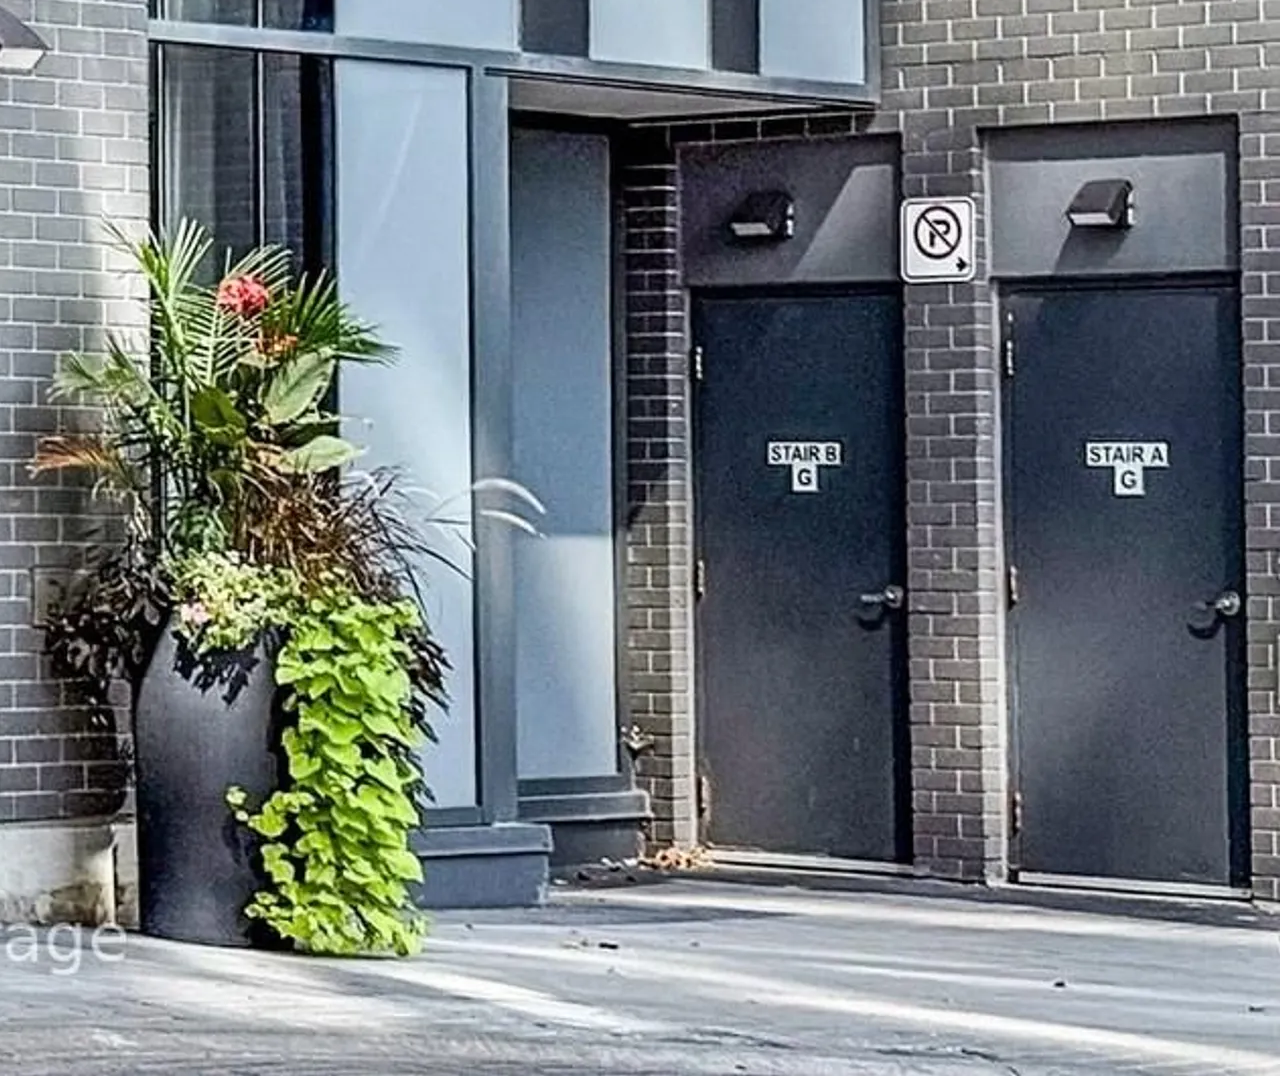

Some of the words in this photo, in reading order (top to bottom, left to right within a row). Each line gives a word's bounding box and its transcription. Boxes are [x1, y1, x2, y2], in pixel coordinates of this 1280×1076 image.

[771, 445, 820, 462] STAIR
[825, 445, 837, 462] B
[1089, 445, 1144, 463] STAIR
[1151, 445, 1164, 463] A
[797, 469, 812, 486] G
[1121, 470, 1137, 489] G
